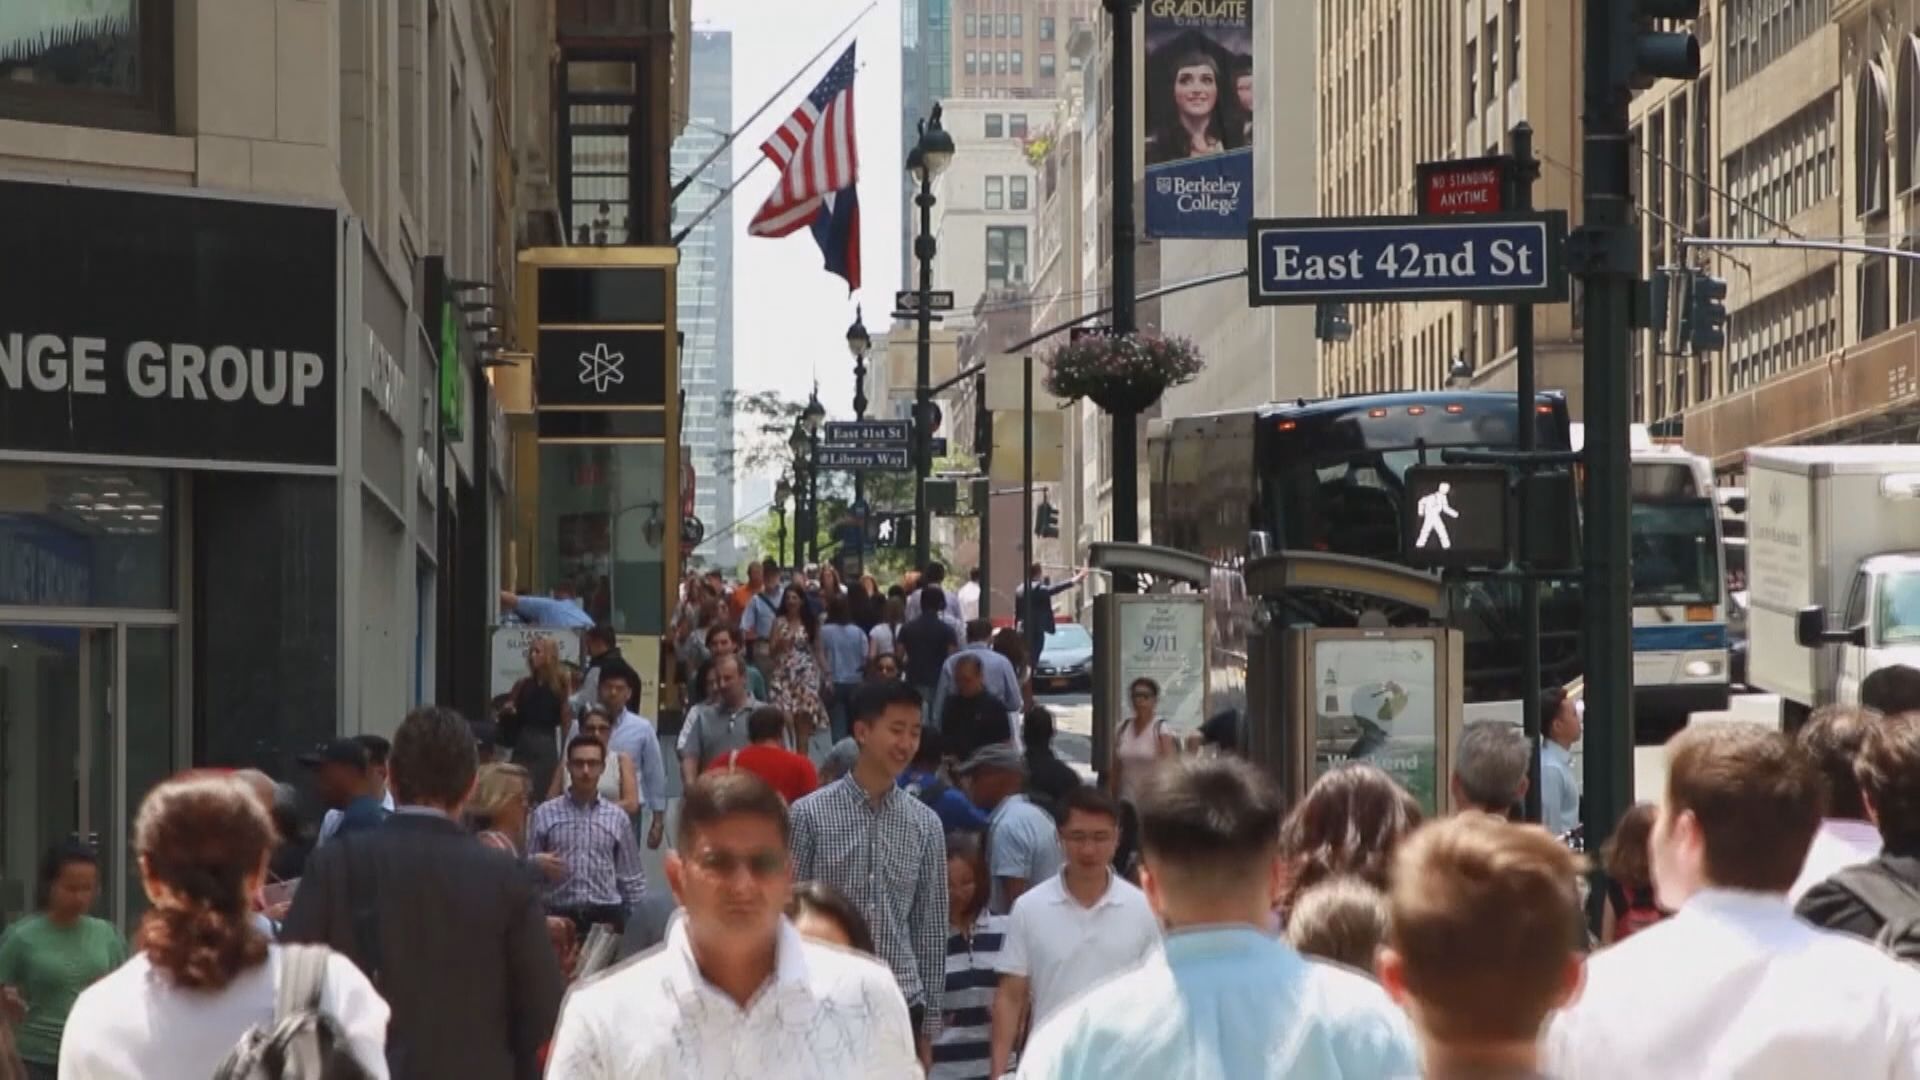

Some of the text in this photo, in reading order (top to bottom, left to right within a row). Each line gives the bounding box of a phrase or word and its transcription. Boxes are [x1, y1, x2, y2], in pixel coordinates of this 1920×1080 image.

[1151, 0, 1247, 18] GRADUATE
[1174, 175, 1241, 198] Berkeley
[1432, 169, 1495, 189] NO STANDING
[1177, 194, 1239, 216] College
[1441, 188, 1489, 207] ANYTIME
[1272, 238, 1533, 281] East 42nd St
[126, 340, 324, 406] GROUP
[833, 427, 902, 439] East 41st St
[876, 453, 904, 467] Way
[1143, 635, 1177, 653] 9/11
